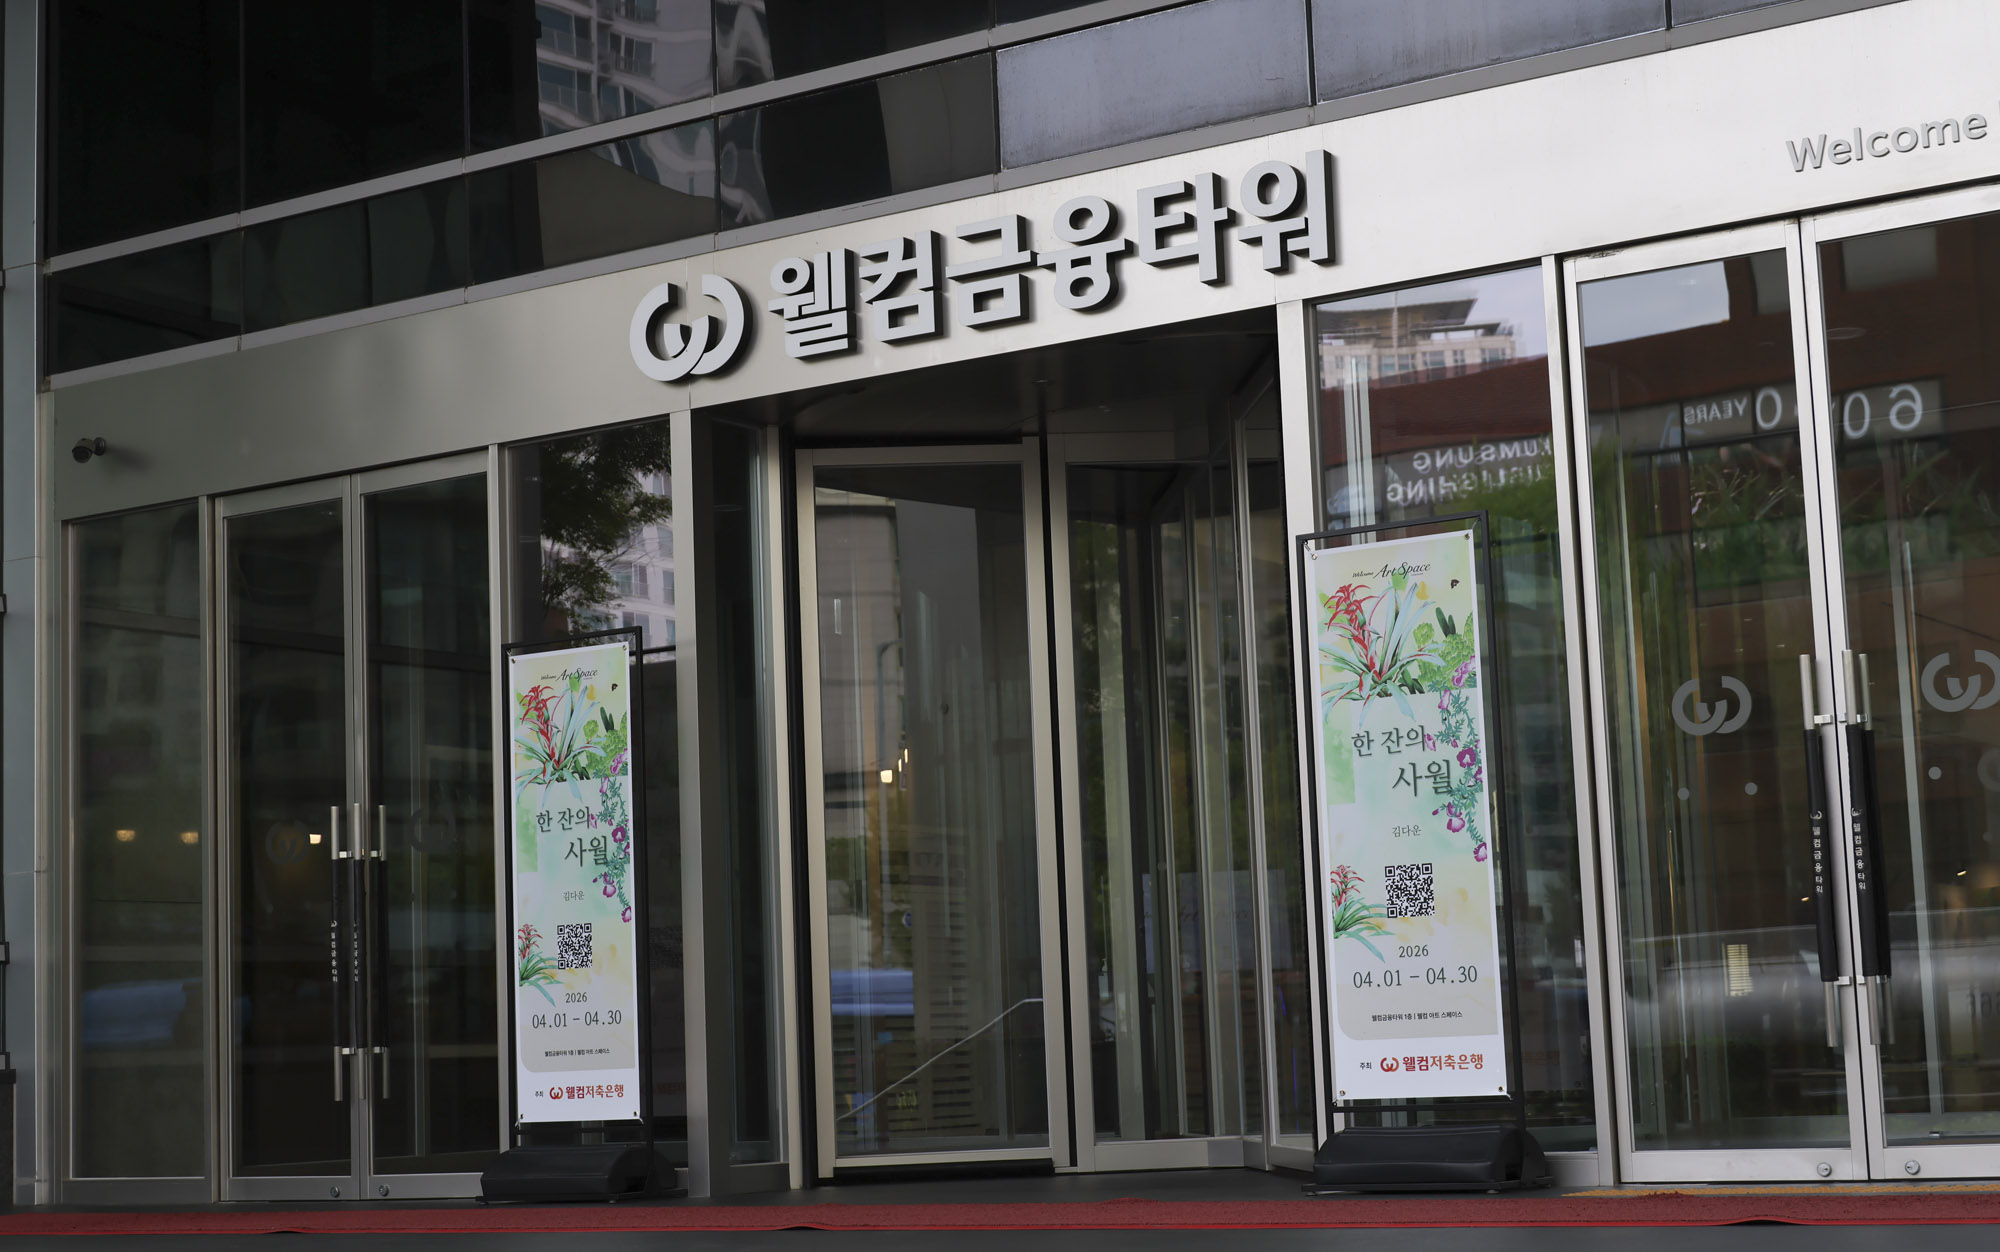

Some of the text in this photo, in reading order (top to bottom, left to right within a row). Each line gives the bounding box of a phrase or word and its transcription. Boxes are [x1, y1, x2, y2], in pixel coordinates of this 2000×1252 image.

[1785, 113, 1988, 173] Welcome
[769, 149, 1335, 358] 웰컴금융타워
[1373, 563, 1396, 579] Art
[1398, 561, 1431, 579] Space
[1351, 725, 1426, 757] 한 잔의
[1392, 759, 1452, 797] 사월
[536, 806, 590, 833] 한 잔의
[1391, 824, 1422, 838] 김다운
[564, 835, 608, 867] 사월
[563, 890, 585, 902] 김다운
[1398, 944, 1429, 959] 2026
[1353, 969, 1402, 989] 04.01
[1426, 965, 1478, 985] 04.30
[565, 992, 588, 1004] 2026
[532, 1013, 567, 1029] 04.01
[584, 1009, 622, 1026] 04.30
[1359, 1053, 1484, 1072] 주최 웰컴저축은행
[565, 1083, 624, 1100] 웰컴저축은행
